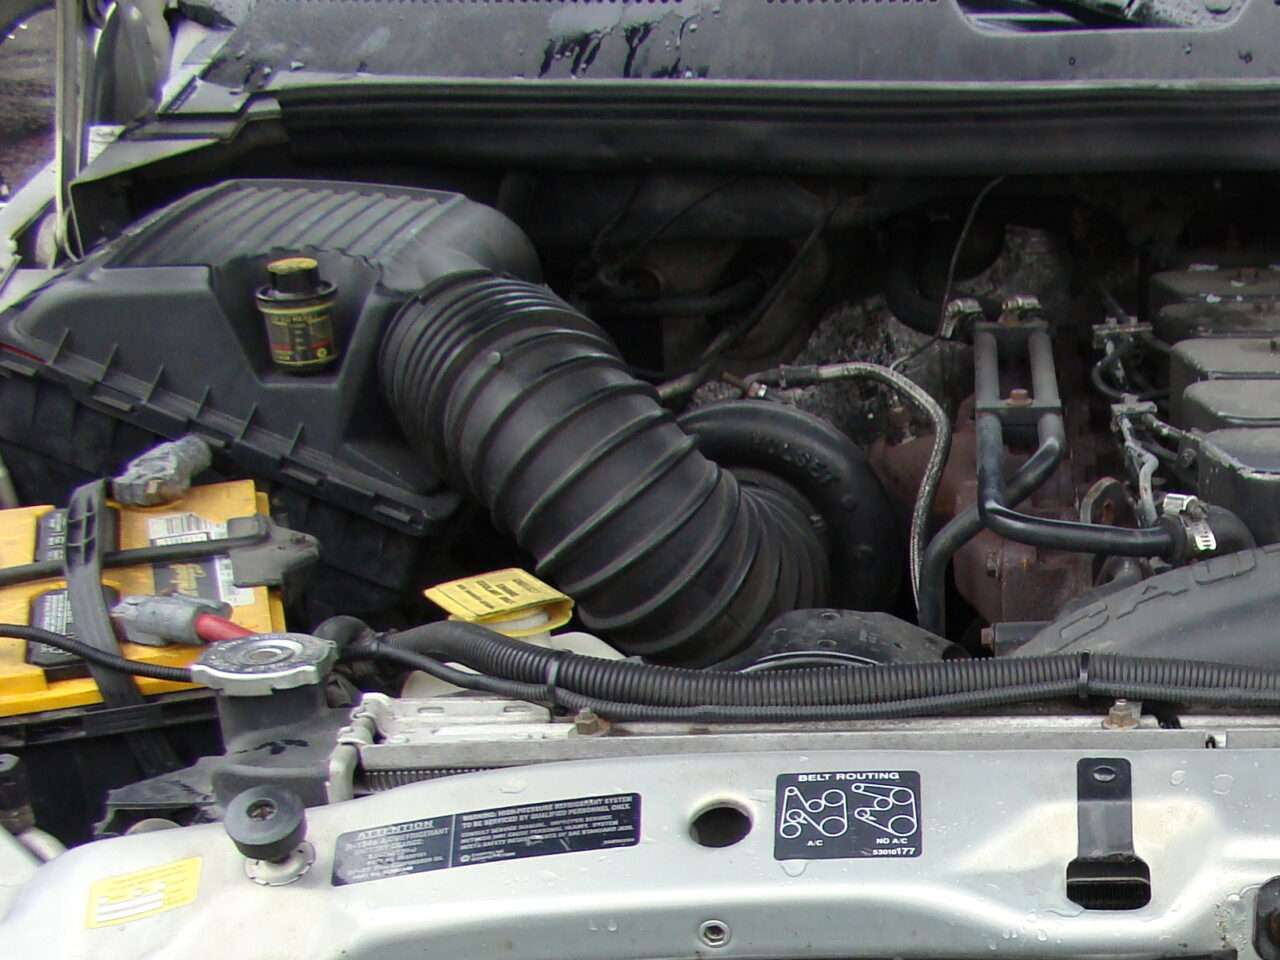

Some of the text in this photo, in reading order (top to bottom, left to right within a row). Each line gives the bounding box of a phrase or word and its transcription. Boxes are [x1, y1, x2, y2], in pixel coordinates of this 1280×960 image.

[798, 771, 900, 782] BELT ROUTING
[807, 839, 824, 847] A/C
[875, 837, 909, 845] NO A/C
